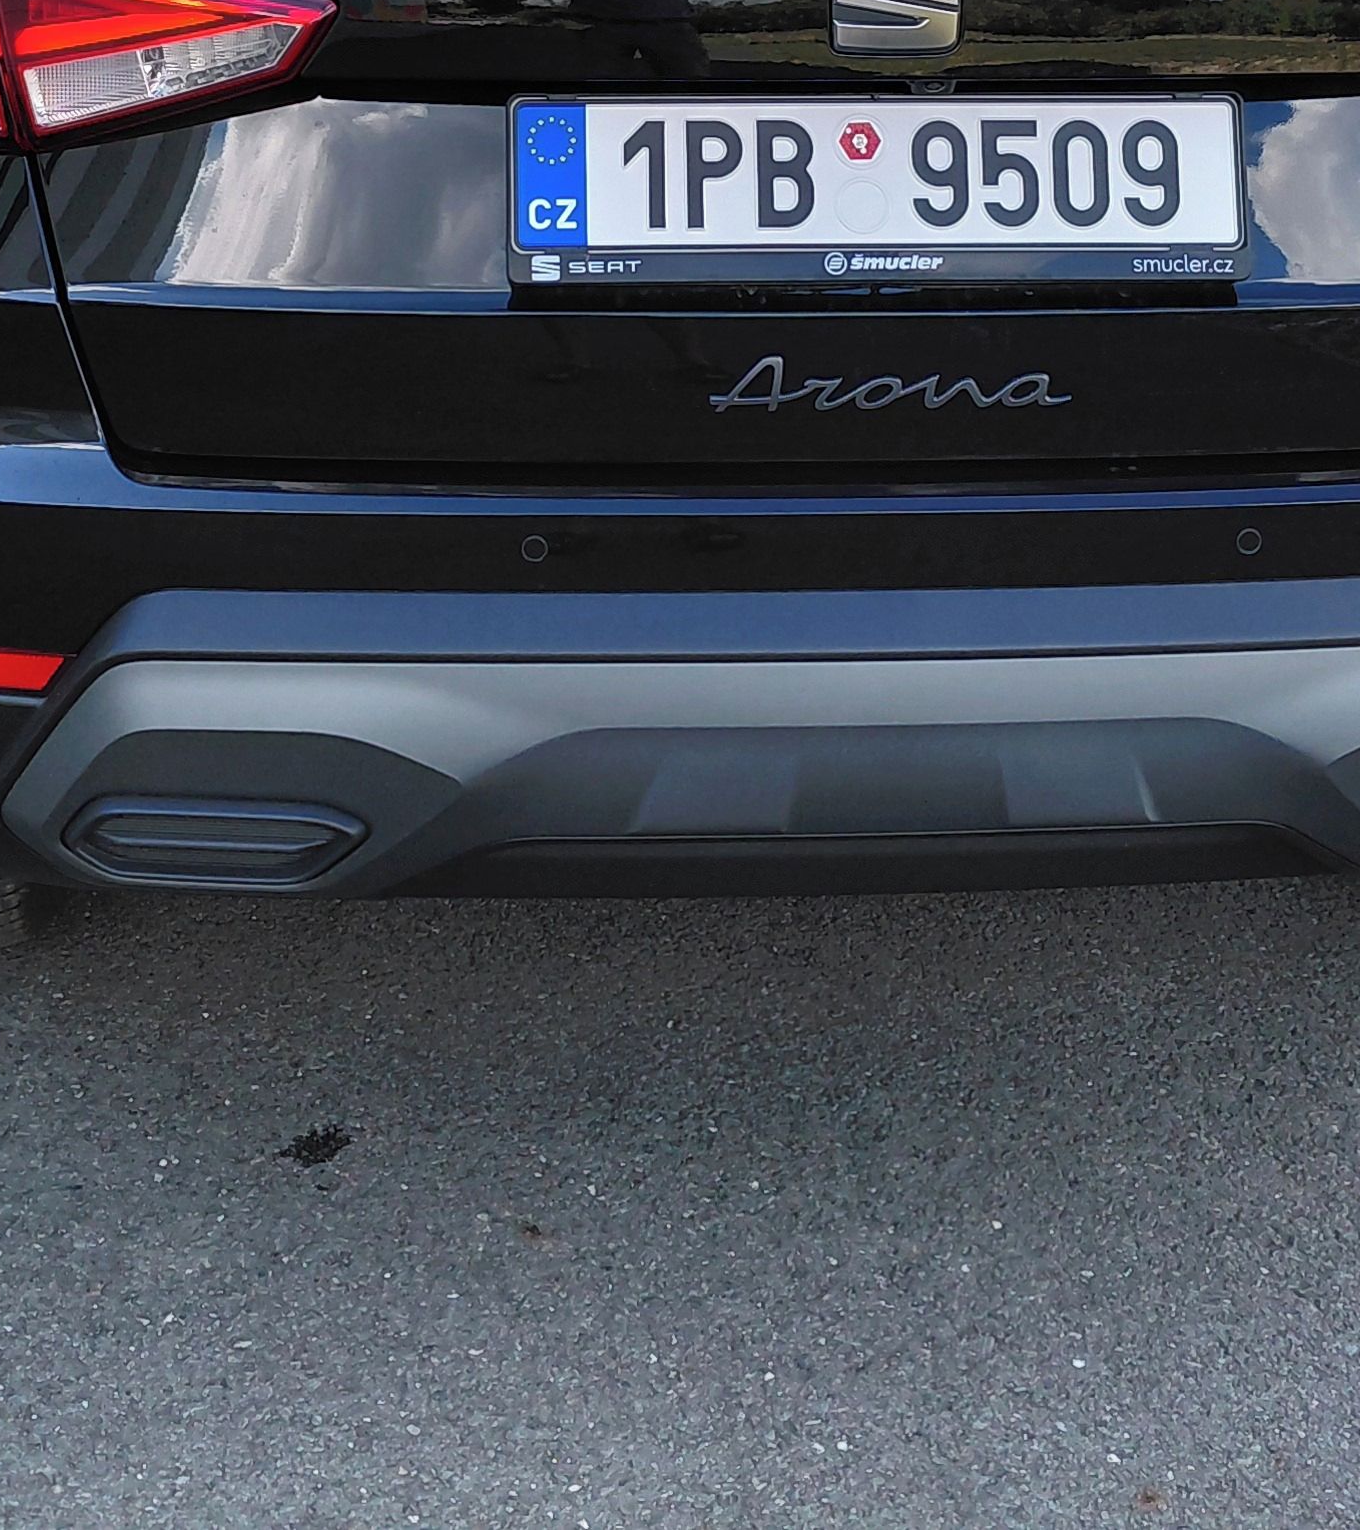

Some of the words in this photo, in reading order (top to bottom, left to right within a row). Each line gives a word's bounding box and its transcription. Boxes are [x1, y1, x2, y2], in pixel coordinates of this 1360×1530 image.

[623, 119, 816, 229] 1PB
[910, 119, 1182, 228] 9509
[528, 199, 578, 230] CZ
[568, 260, 642, 274] SEAT
[849, 253, 944, 271] šmucler
[1133, 253, 1234, 273] smucler.cz
[709, 355, 1072, 412] Arona
